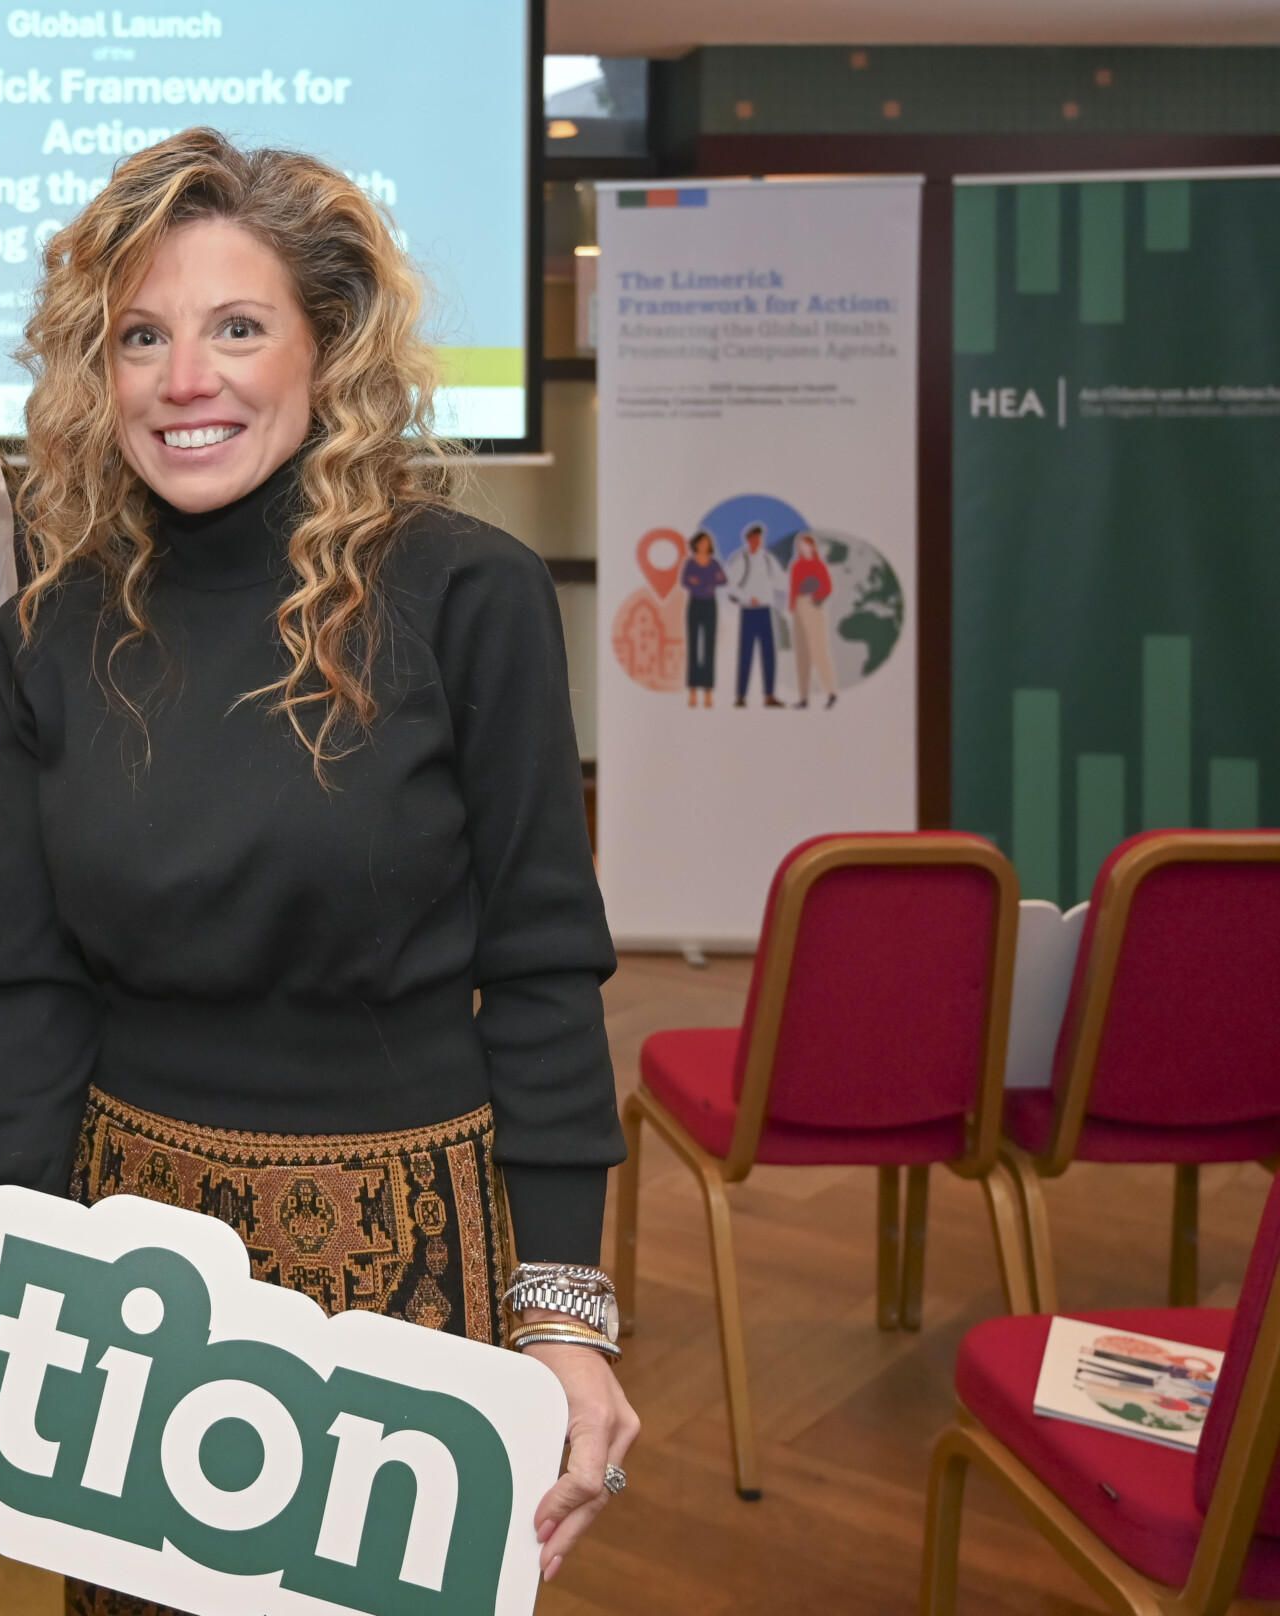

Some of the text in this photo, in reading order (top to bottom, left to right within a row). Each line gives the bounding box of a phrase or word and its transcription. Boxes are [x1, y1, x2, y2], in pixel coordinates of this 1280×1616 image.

[7, 12, 221, 39] Global Launch
[60, 68, 286, 105] Framework
[293, 69, 351, 105] for
[618, 270, 783, 290] The Limerick
[618, 296, 757, 315] Framework
[766, 295, 799, 314] for
[619, 320, 891, 341] Advancing the Global Health
[617, 343, 718, 363] Promoting
[824, 341, 897, 361] Agenda
[970, 388, 1045, 418] HEA
